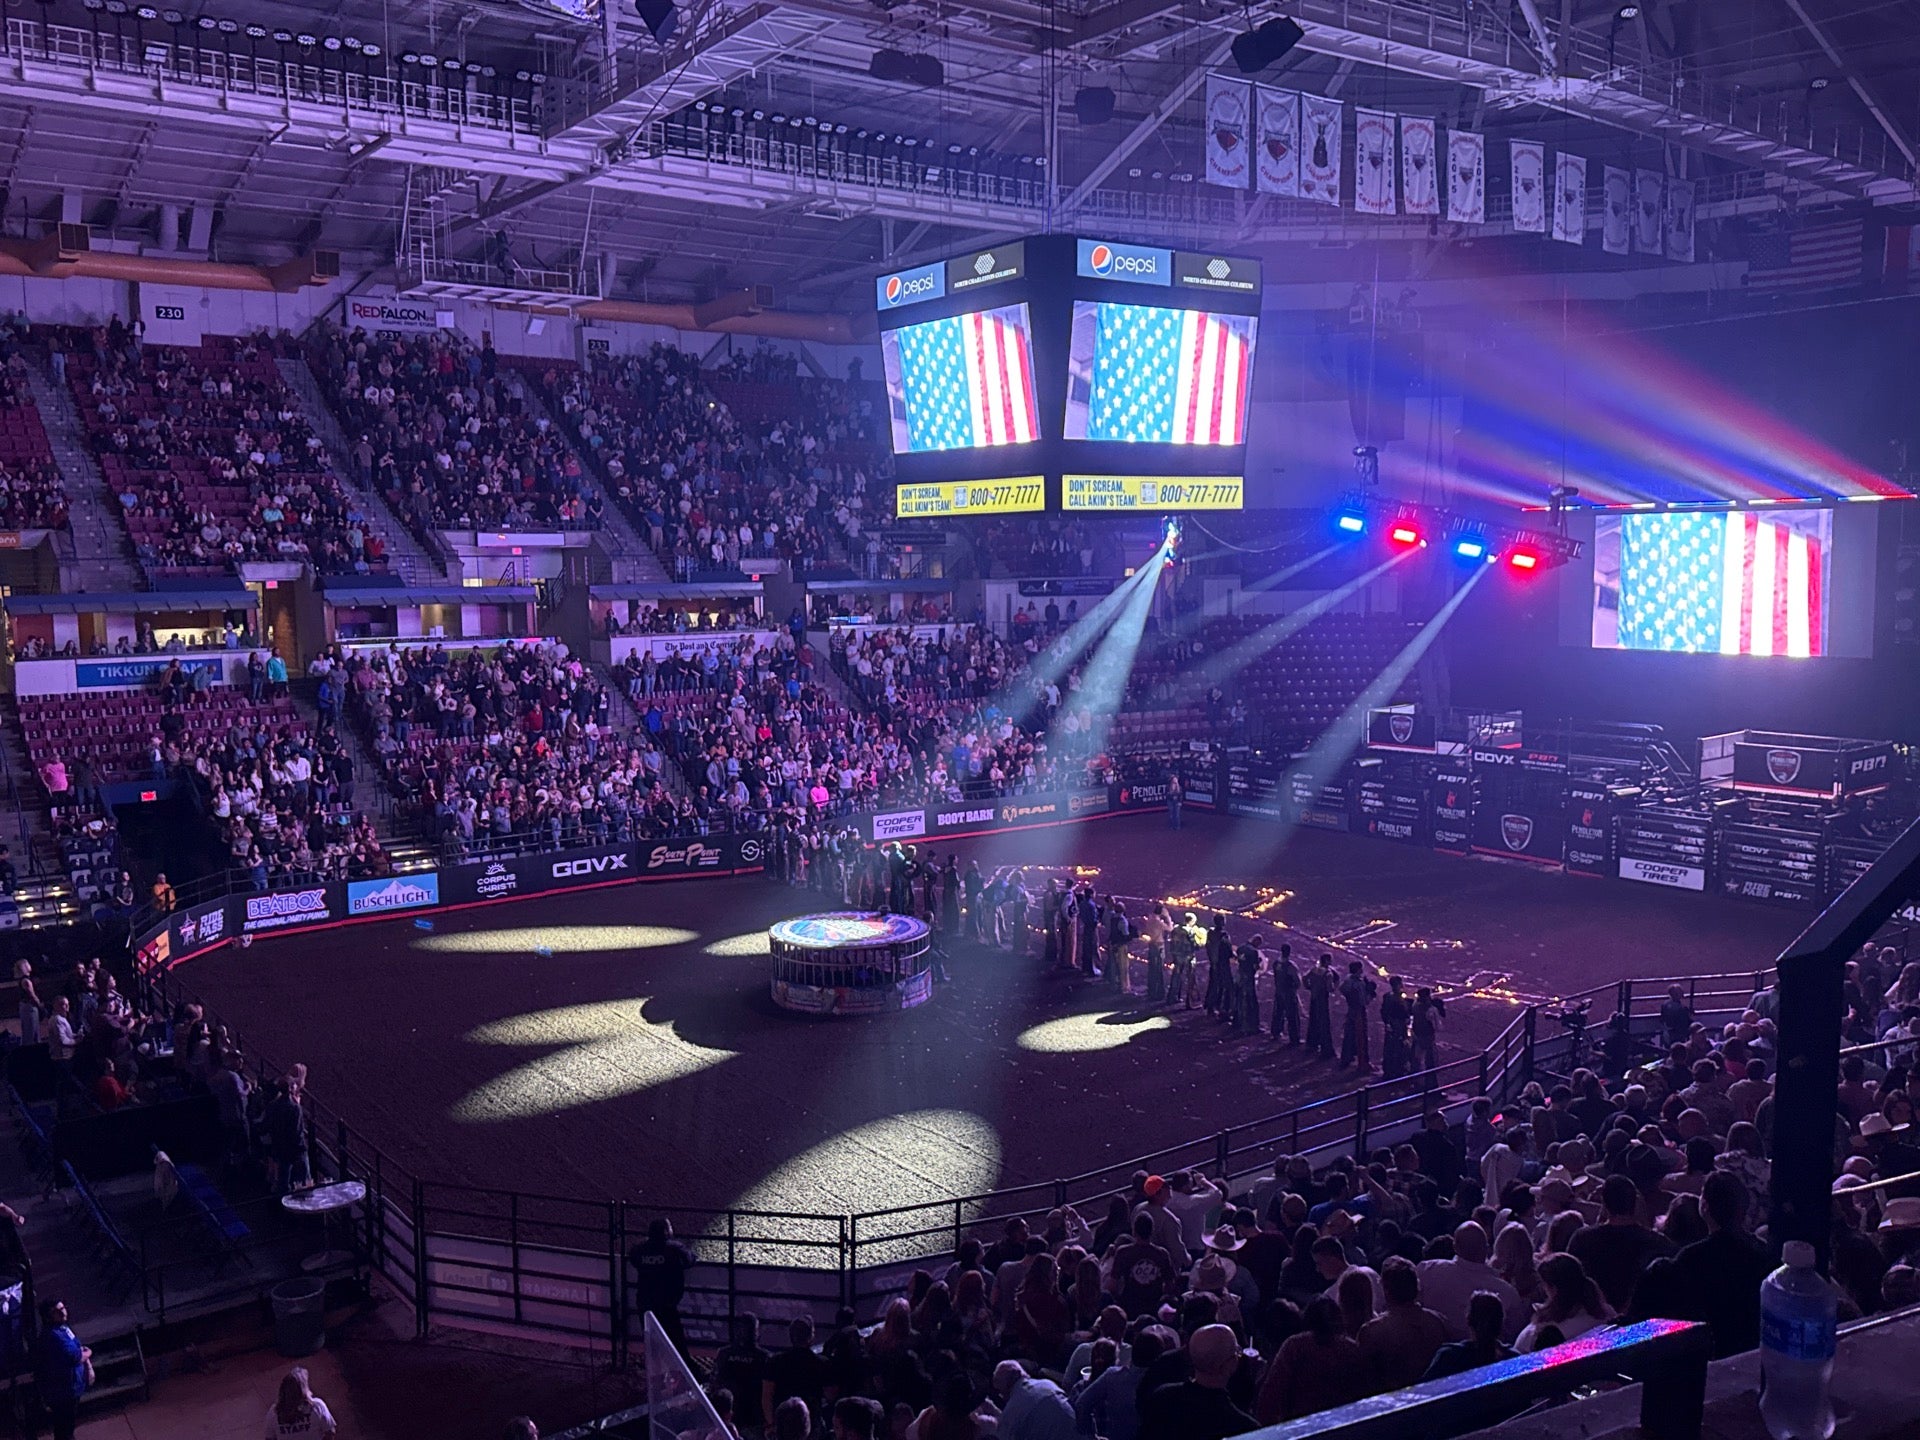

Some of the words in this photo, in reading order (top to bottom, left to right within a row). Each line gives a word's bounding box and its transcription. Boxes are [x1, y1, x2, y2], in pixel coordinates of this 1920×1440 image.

[1114, 256, 1157, 275] pepsi
[902, 273, 935, 298] pepsi
[159, 307, 182, 319] 230
[901, 488, 917, 500] DON'T
[917, 486, 942, 499] SCREAM,
[1069, 480, 1091, 492] DON'T
[1092, 480, 1125, 493] SCREAM,
[901, 502, 914, 513] CALL
[914, 501, 934, 512] AKIM'S
[934, 500, 951, 511] TEAM!
[1069, 494, 1086, 506] CALL
[1088, 494, 1114, 506] AKIM'S
[1116, 494, 1137, 506] TEAM!
[664, 642, 678, 651] The
[680, 641, 695, 651] Post
[696, 640, 708, 649] and
[97, 664, 155, 678] TIKKUN
[1474, 751, 1515, 765] GOVX
[1017, 804, 1056, 815] RAM
[876, 815, 922, 827] COOPER
[937, 812, 965, 826] BOOT
[965, 808, 995, 824] BARN
[883, 824, 915, 834] TIRES
[1376, 821, 1412, 837] PENDLETON
[552, 853, 628, 878] GOVX
[1634, 863, 1689, 876] COOPER
[476, 873, 516, 885] CORPUS
[1641, 871, 1680, 883] TIRES
[476, 881, 517, 894] CHRISTI
[247, 888, 327, 919] BEATBOX
[354, 895, 395, 910] BUSCH
[395, 890, 432, 904] LIGHT
[199, 908, 224, 928] RIDE
[244, 919, 258, 930] THE
[199, 918, 223, 939] PASS
